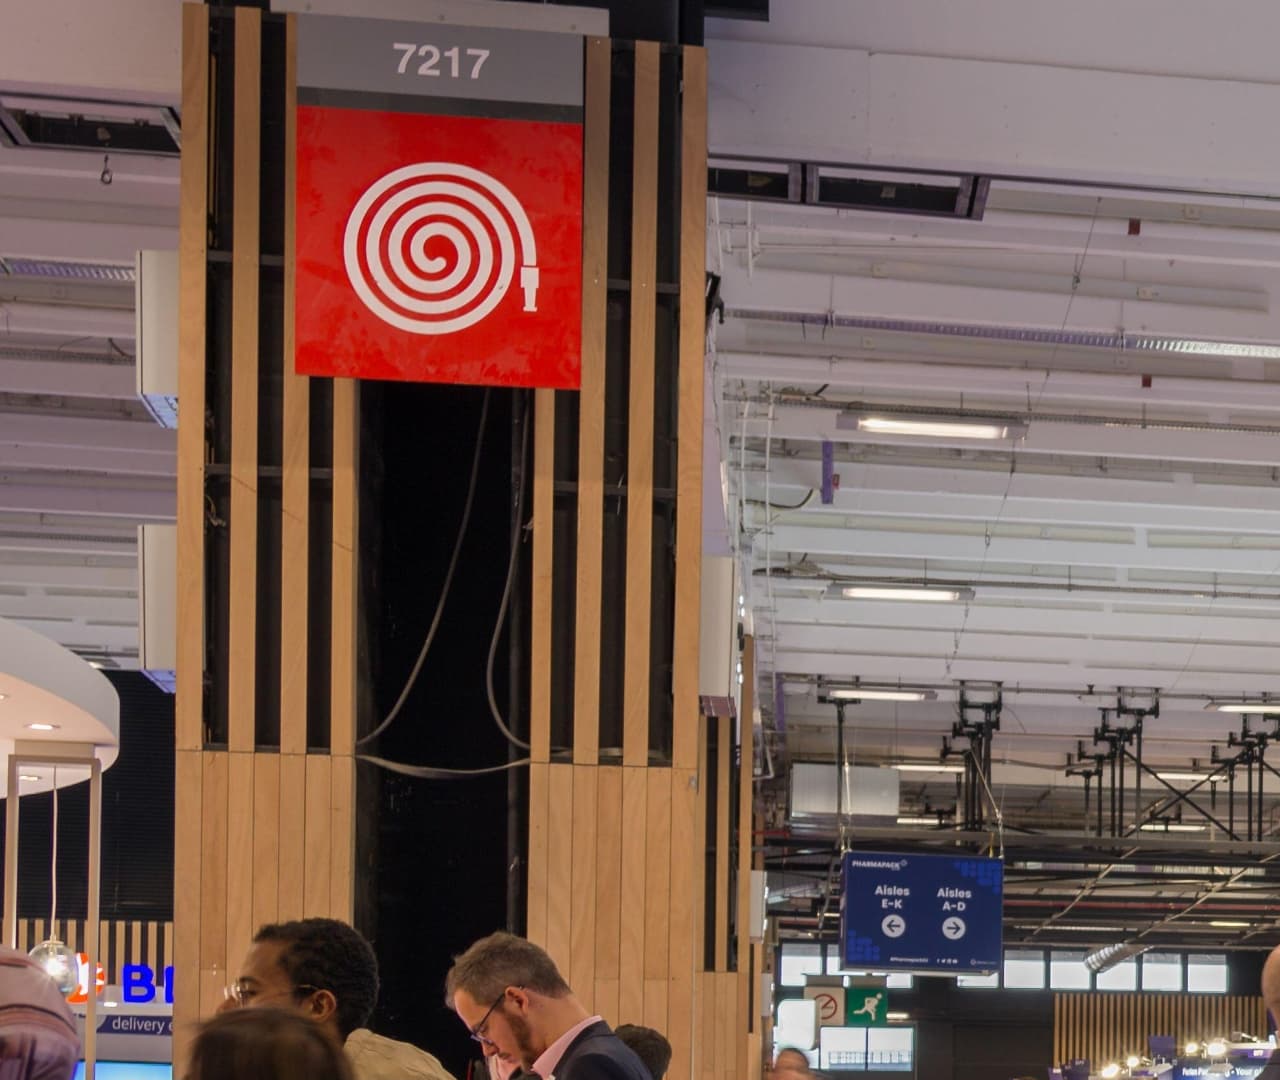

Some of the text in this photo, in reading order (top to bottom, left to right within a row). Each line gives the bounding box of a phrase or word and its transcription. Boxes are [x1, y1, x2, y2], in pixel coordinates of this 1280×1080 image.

[392, 42, 490, 79] 7217
[874, 885, 910, 897] Aisles
[937, 887, 972, 899] Aisles
[881, 898, 903, 909] E-K
[942, 901, 966, 912] A-D
[122, 963, 174, 1004] B
[112, 1016, 165, 1035] delivery
